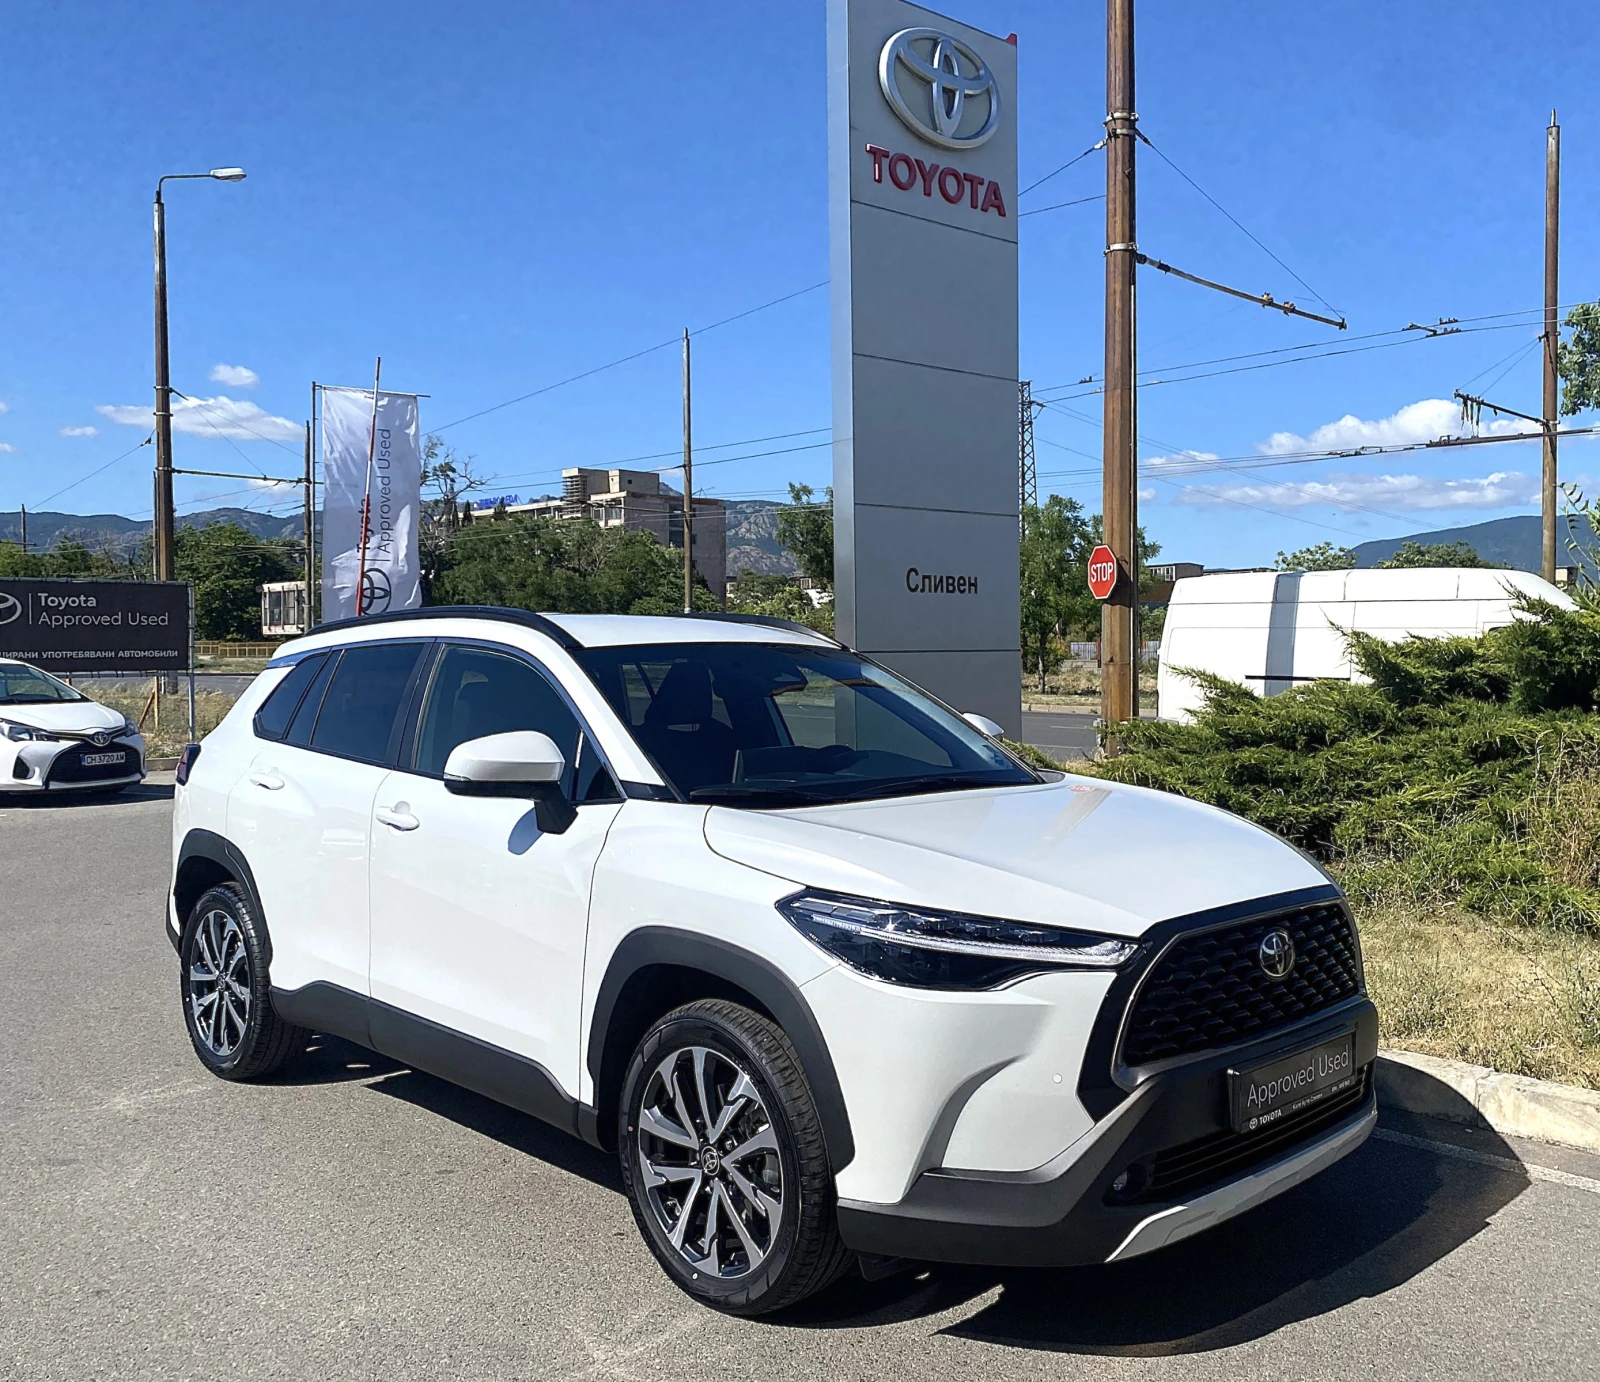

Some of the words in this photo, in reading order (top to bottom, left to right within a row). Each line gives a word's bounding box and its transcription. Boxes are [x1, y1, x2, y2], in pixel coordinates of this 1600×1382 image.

[865, 143, 1006, 217] TOYOTA
[377, 428, 391, 470] Used
[377, 476, 394, 554] Approved
[905, 567, 978, 595] Сливен
[1090, 562, 1114, 583] STOP
[37, 592, 97, 610] Toyota
[37, 611, 122, 629] Approved
[128, 612, 169, 626] Used
[41, 650, 115, 659] УПОТРЕБЯВАНИ
[118, 650, 178, 658] АВТОМОБИЛИ
[1247, 1058, 1315, 1109] Approved
[1318, 1044, 1349, 1077] Used
[1259, 1109, 1282, 1125] TOYOTA
